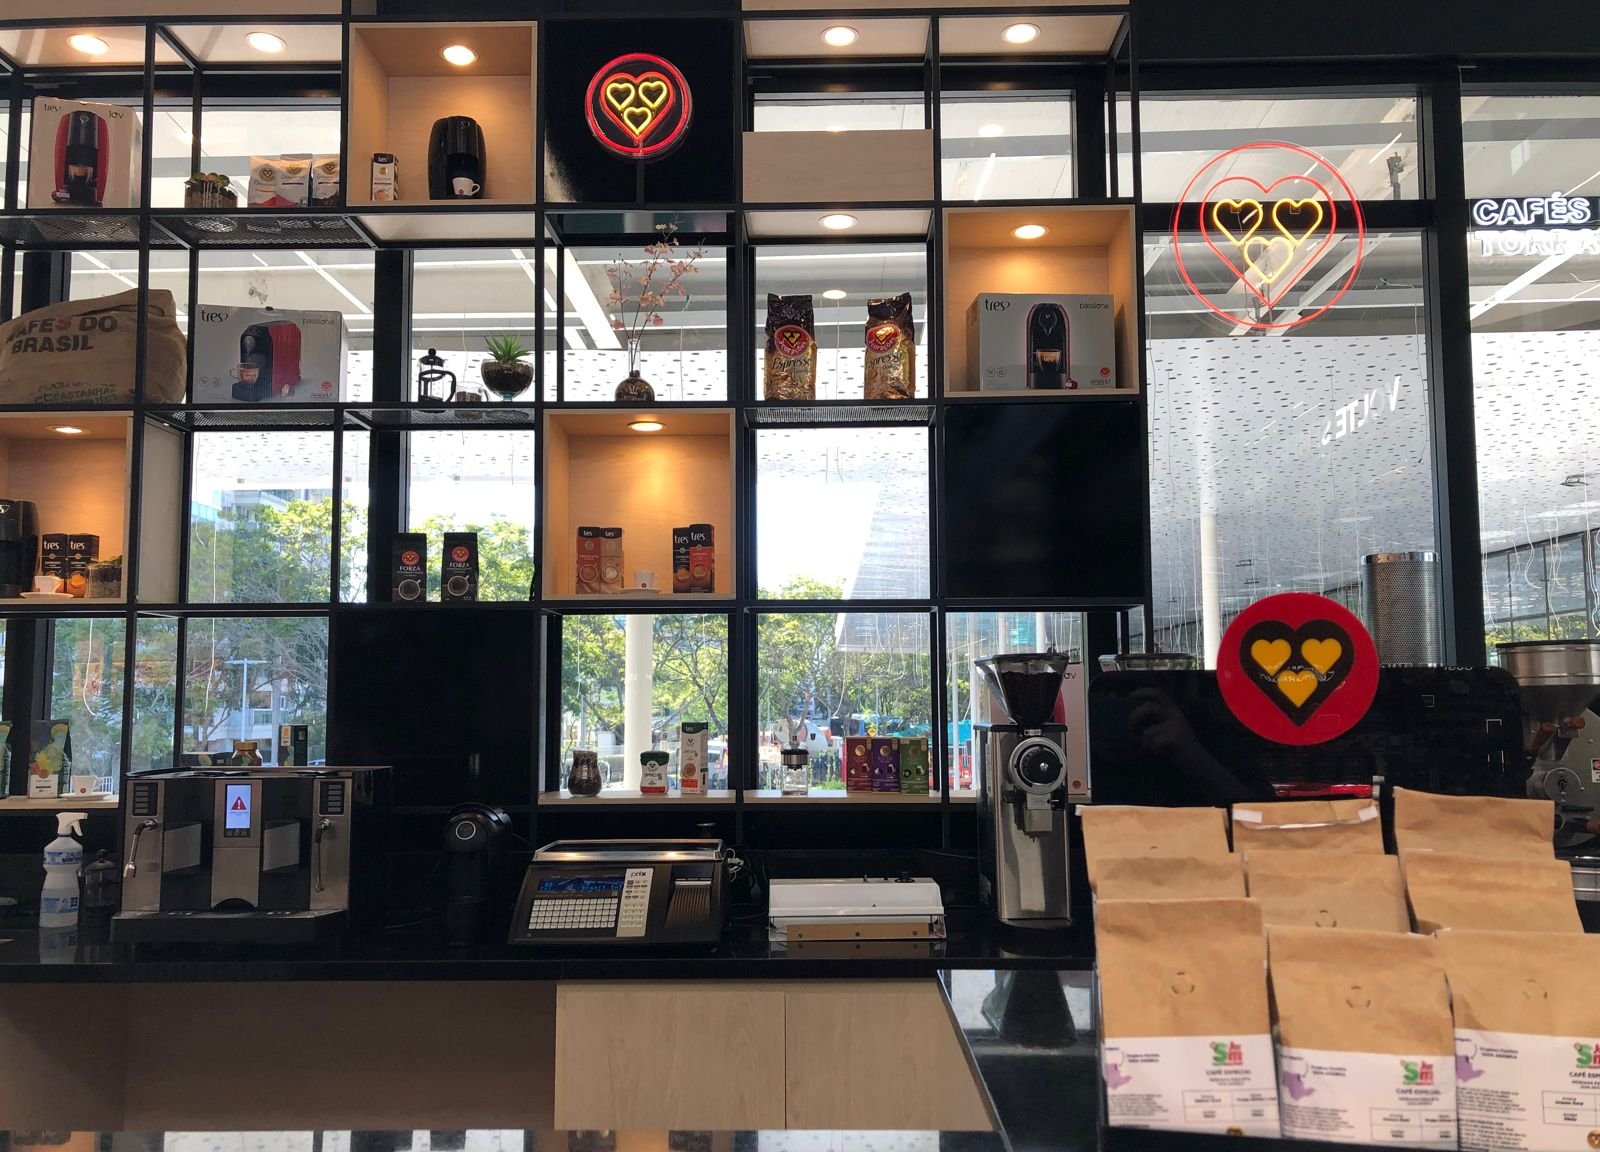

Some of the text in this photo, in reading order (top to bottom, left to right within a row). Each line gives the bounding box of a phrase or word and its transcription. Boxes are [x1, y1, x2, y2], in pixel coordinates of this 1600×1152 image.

[1473, 191, 1591, 225] CAFÉS
[985, 298, 1006, 312] tres
[201, 309, 223, 323] tres
[78, 315, 118, 332] DO
[11, 334, 94, 354] BRASIL
[674, 534, 689, 544] tres
[691, 531, 706, 541] tres
[43, 540, 60, 550] tres
[70, 540, 85, 550] tres
